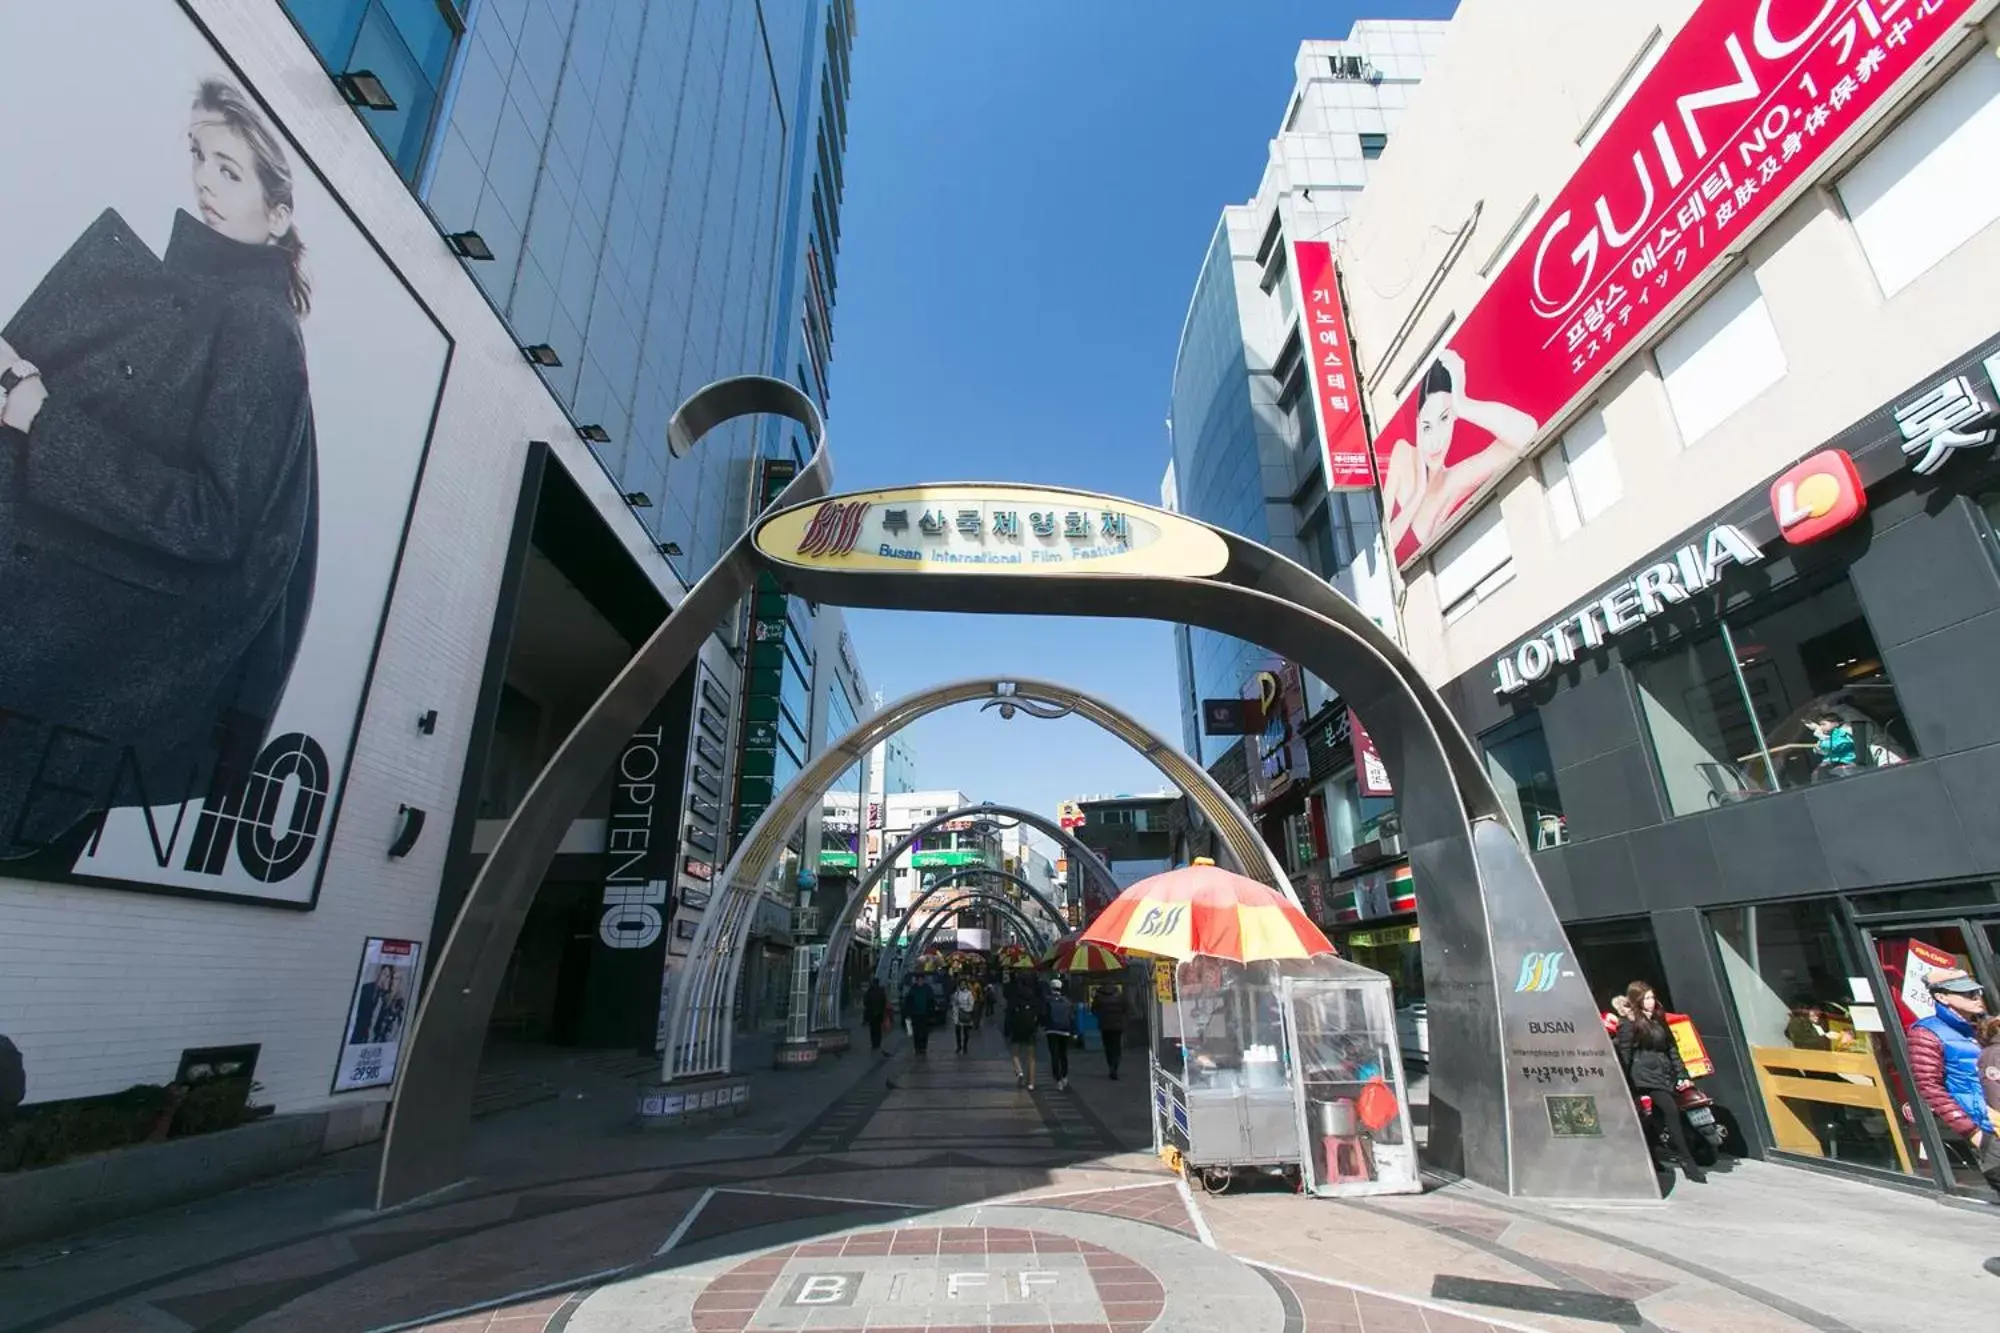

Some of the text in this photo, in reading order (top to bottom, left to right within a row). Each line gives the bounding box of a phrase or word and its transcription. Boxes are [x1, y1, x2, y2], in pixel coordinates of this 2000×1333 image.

[1566, 283, 1628, 353] 프랑스
[1632, 161, 1733, 279] 에스테틱
[1313, 289, 1348, 412] 기노에스테틱
[882, 507, 1129, 541] 부산국제영화제
[879, 543, 1133, 565] Busan International Film Festival
[1493, 524, 1765, 694] LOTTERIA
[1528, 1021, 1576, 1034] BUSAN
[1521, 1066, 1605, 1083] 부산국제영화제
